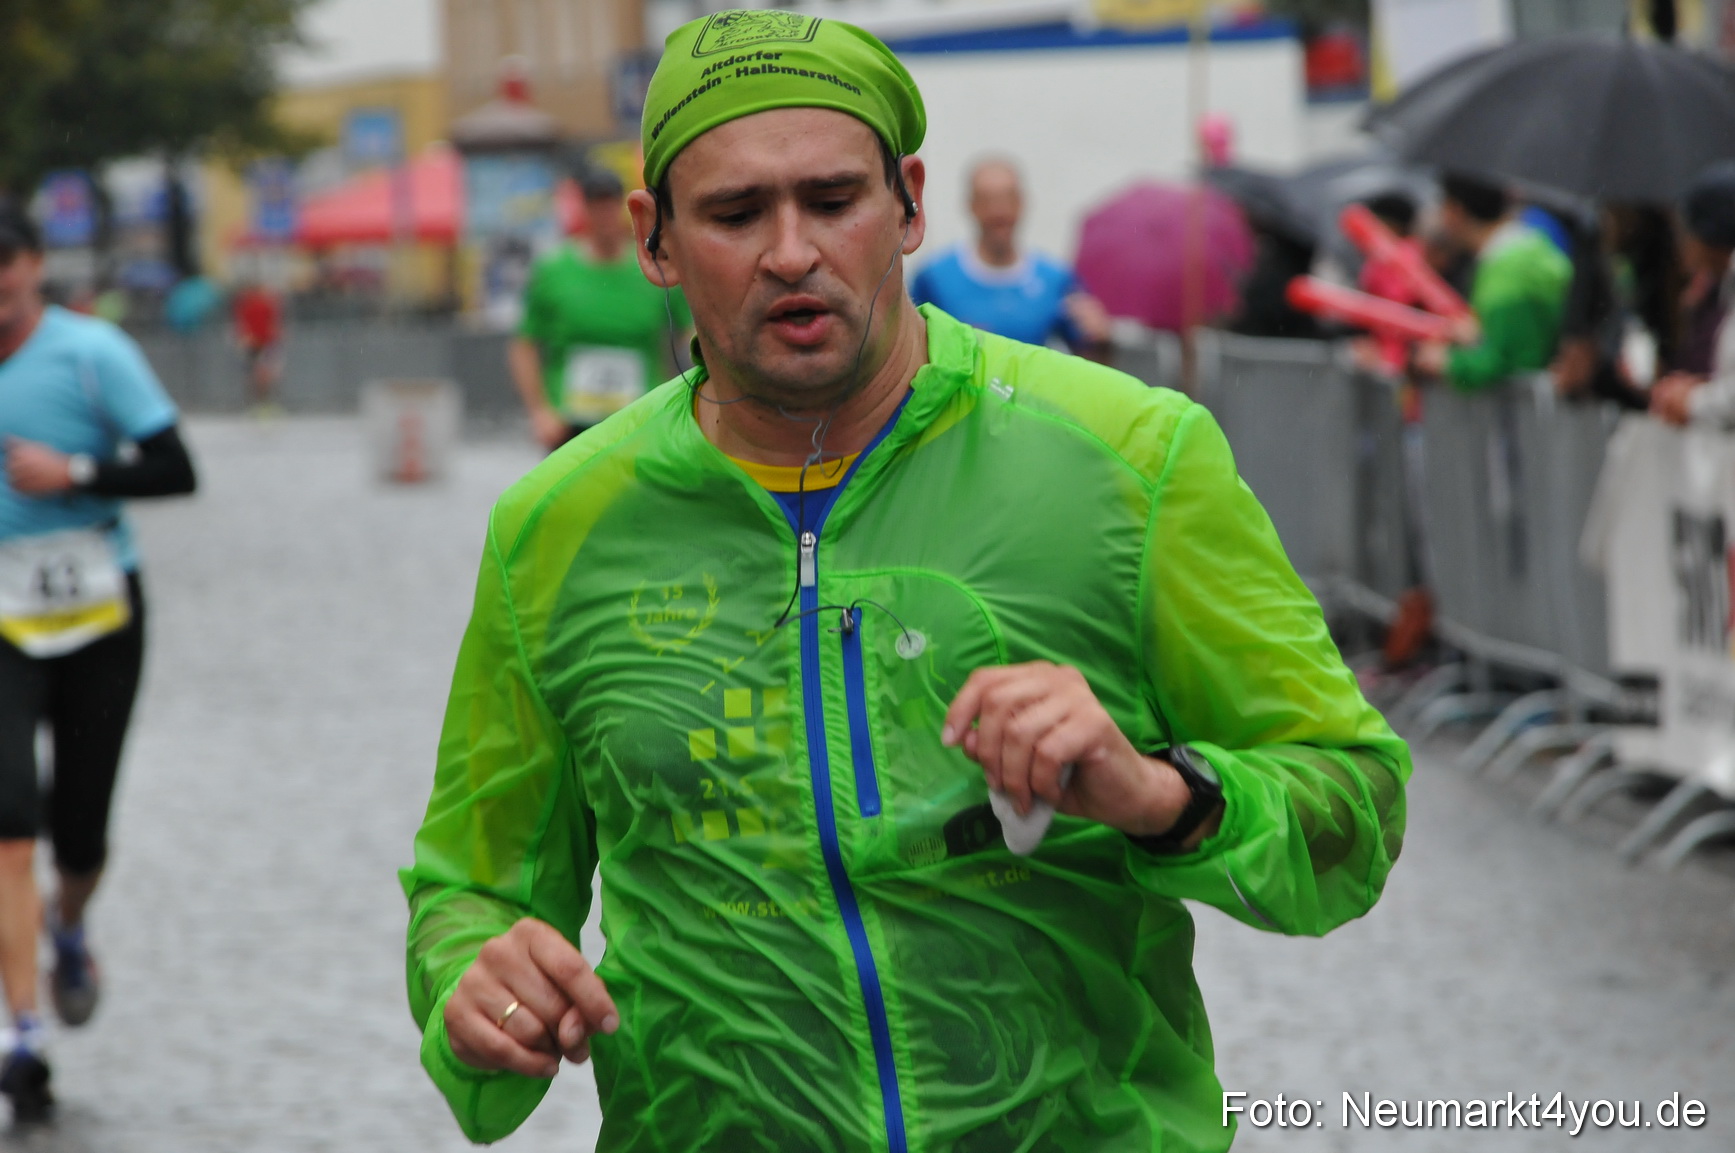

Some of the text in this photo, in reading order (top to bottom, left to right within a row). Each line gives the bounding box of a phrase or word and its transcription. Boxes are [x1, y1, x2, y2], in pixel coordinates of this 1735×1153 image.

[700, 50, 783, 79] Altdorfer
[651, 76, 722, 140] Wallenstein
[735, 63, 862, 95] Halbmarathon
